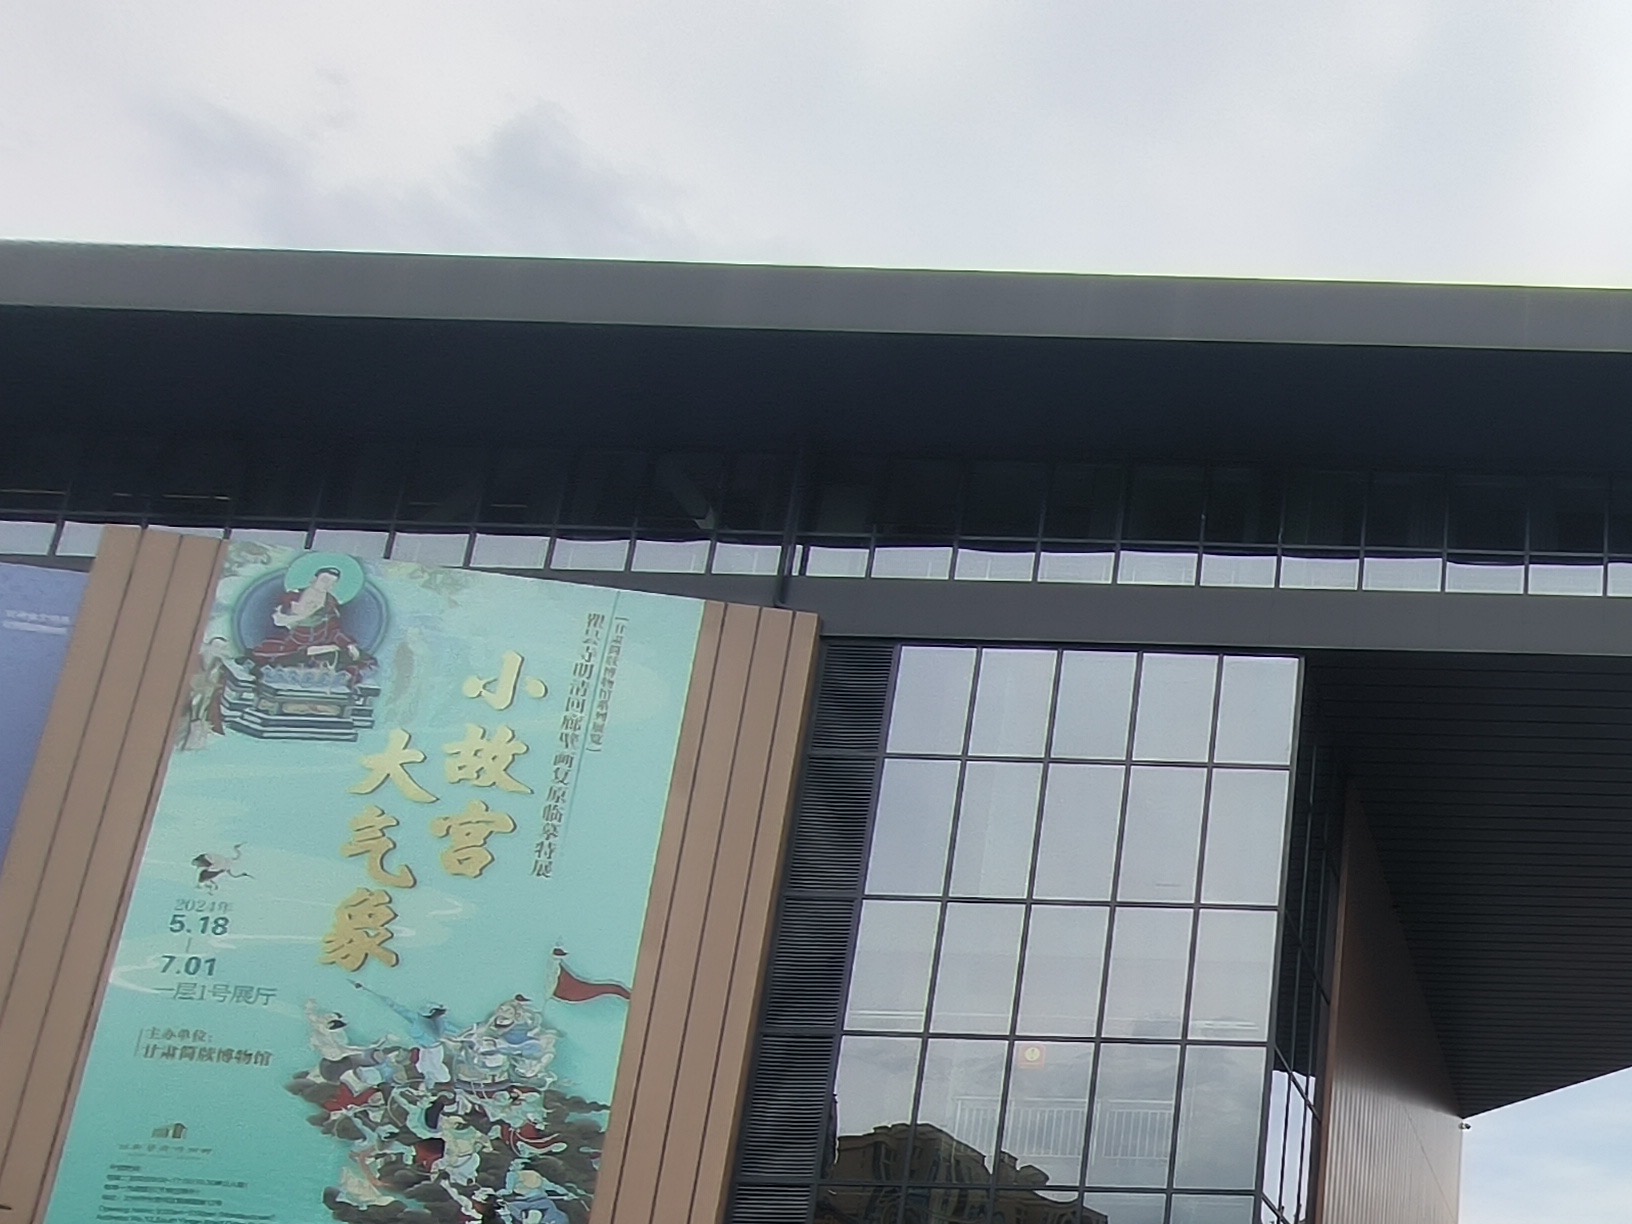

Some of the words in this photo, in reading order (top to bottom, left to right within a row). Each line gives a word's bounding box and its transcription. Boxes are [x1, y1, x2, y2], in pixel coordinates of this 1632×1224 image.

[430, 650, 548, 880] 小故宫
[319, 727, 441, 973] 大气象
[169, 914, 230, 936] 5.18
[160, 954, 217, 977] 7.01
[152, 981, 278, 1006] 一层1号展厅
